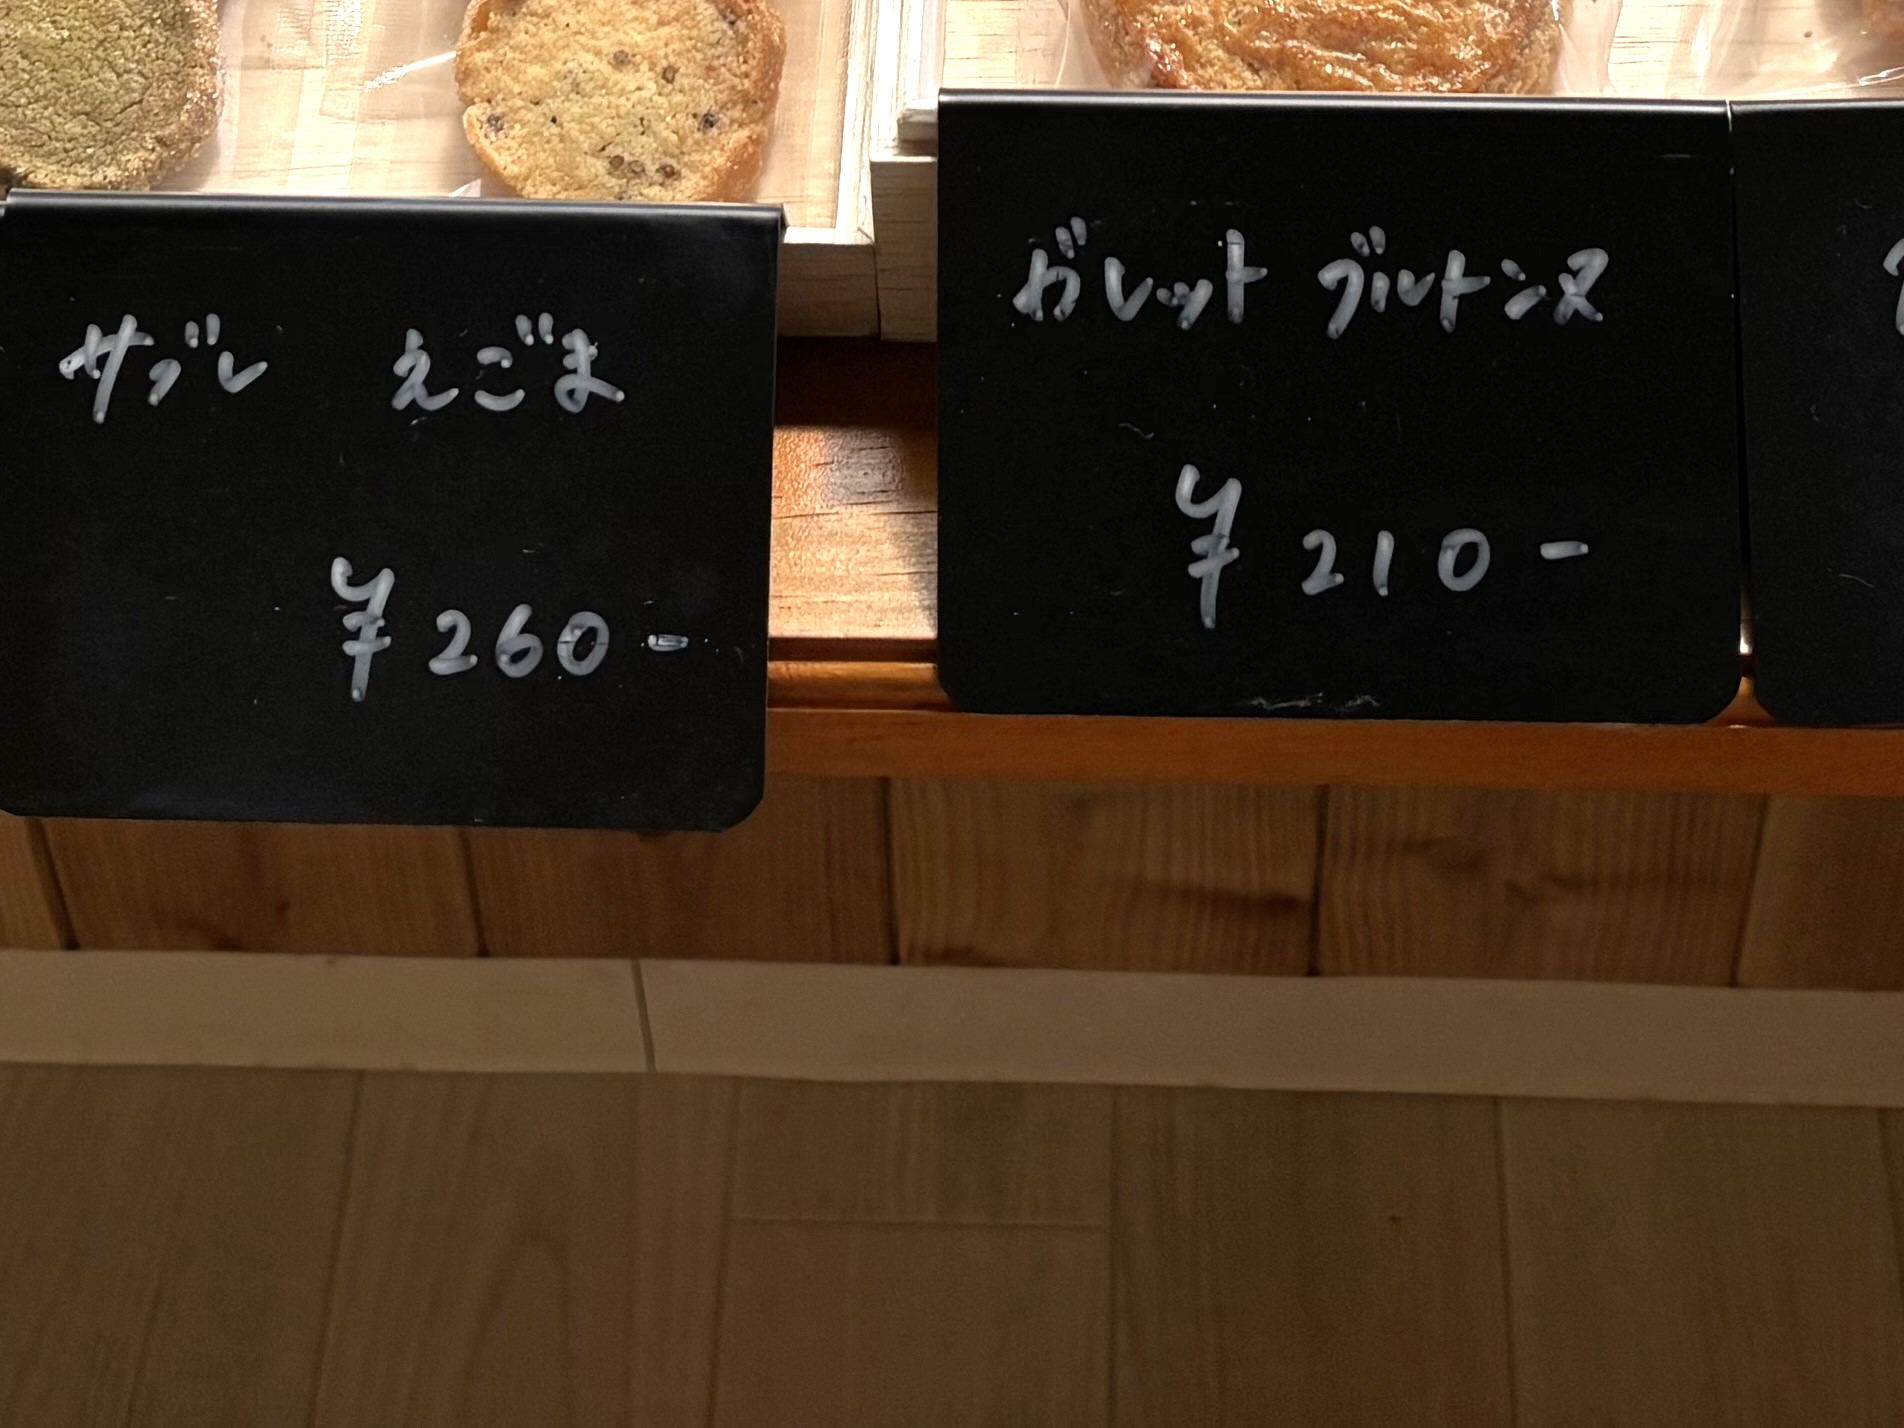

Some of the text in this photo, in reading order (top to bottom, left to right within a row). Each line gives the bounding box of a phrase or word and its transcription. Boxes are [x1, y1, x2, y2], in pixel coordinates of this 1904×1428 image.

[1012, 216, 1610, 340] ガレット ブルトンヌ
[59, 311, 626, 425] サブレ えごま
